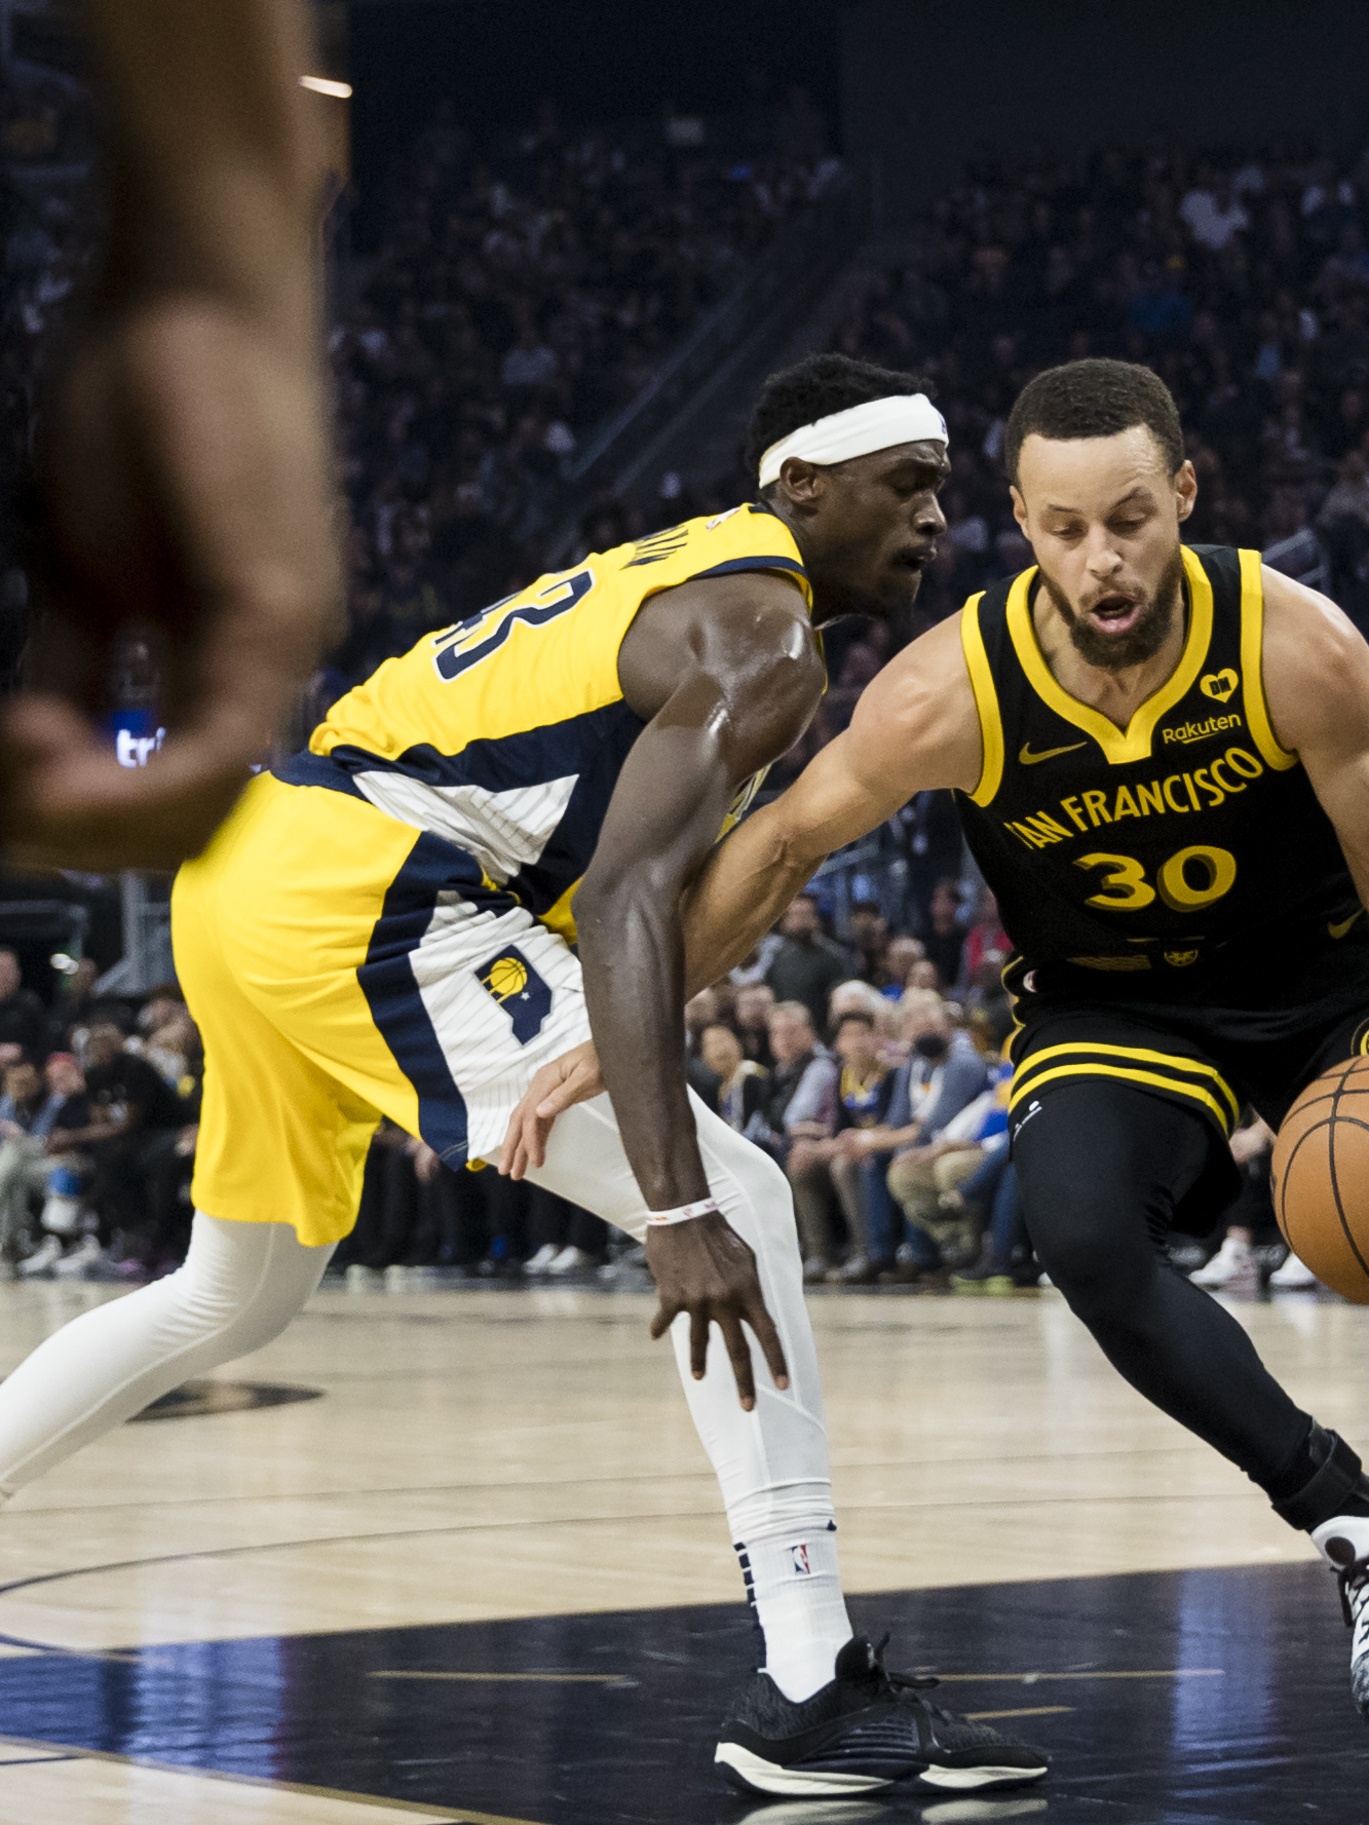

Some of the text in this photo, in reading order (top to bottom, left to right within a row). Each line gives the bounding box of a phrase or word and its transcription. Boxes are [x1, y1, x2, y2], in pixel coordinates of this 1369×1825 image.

[1162, 713, 1242, 745] Rakuten
[1061, 747, 1264, 832] FRANCISCO
[1073, 845, 1237, 912] 30
